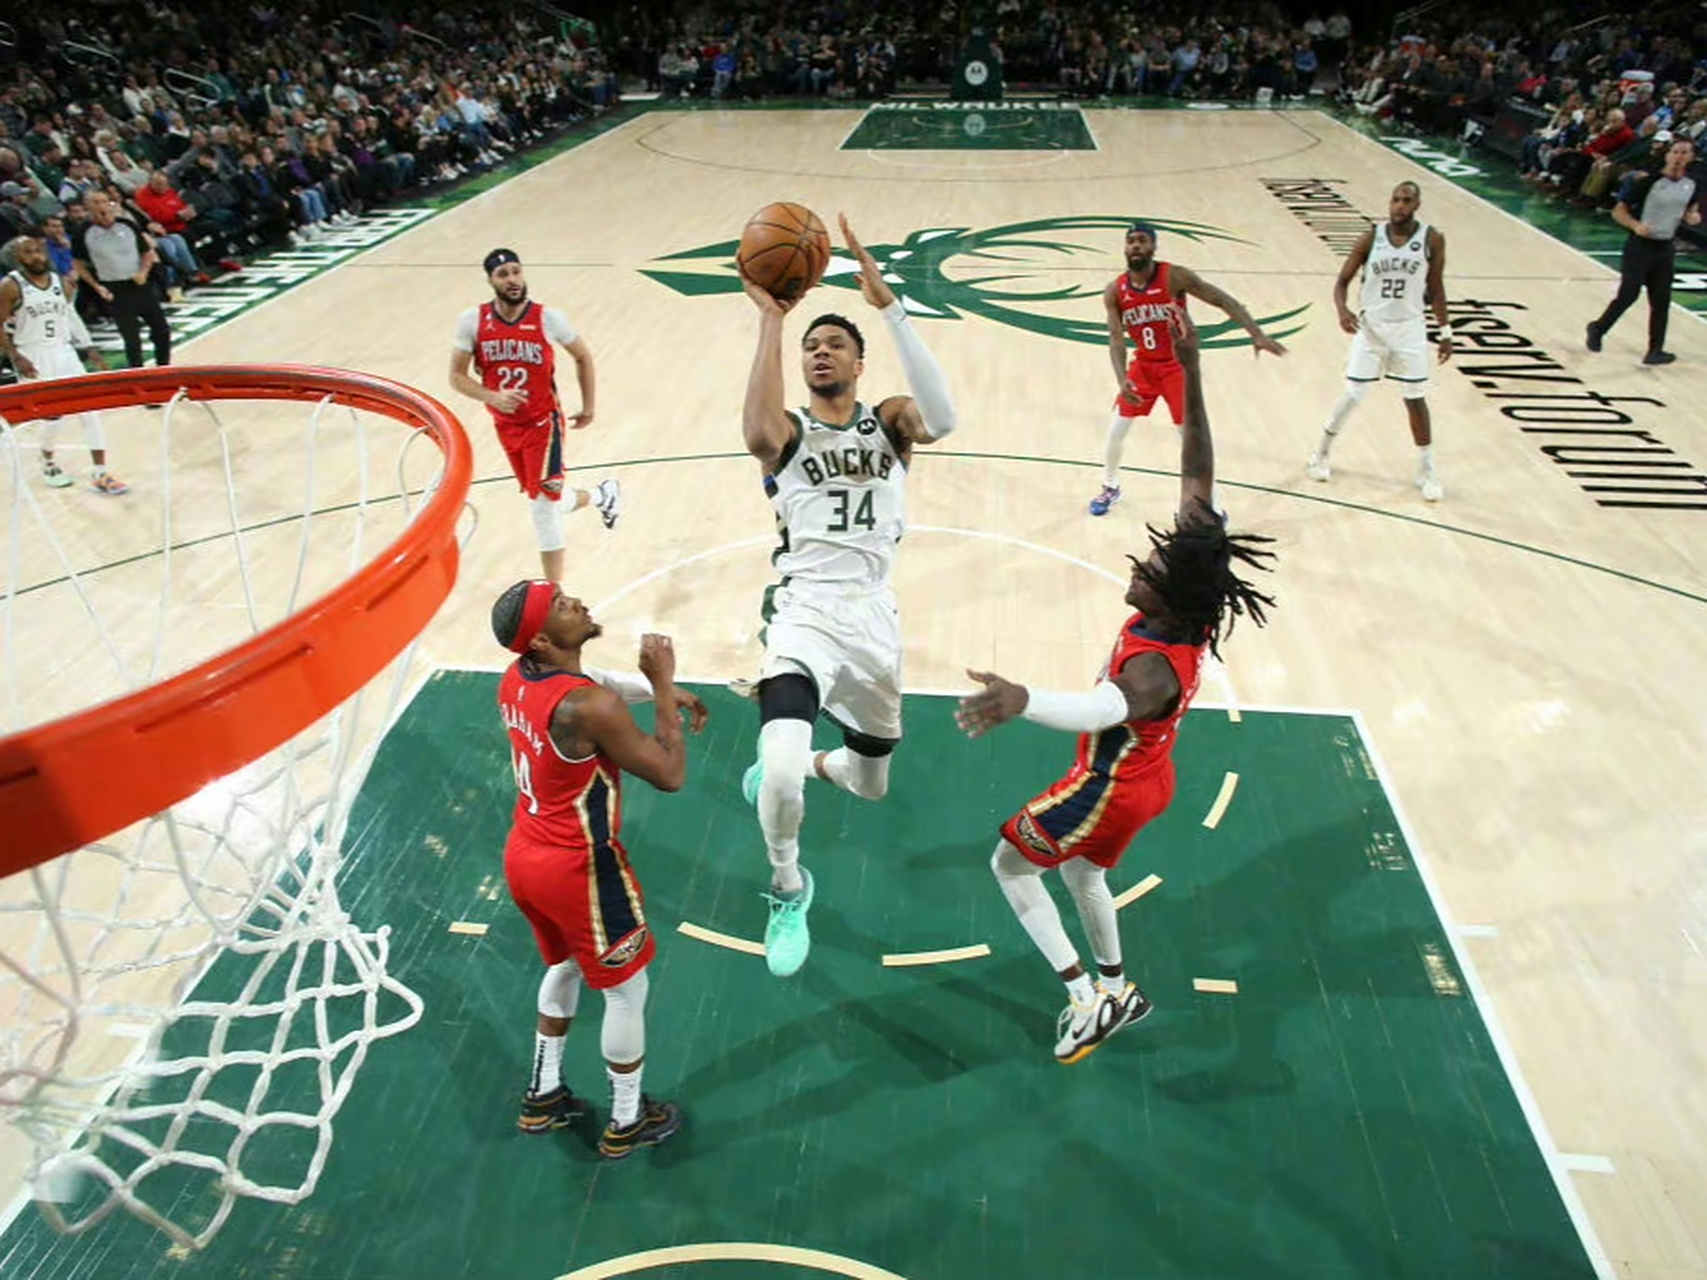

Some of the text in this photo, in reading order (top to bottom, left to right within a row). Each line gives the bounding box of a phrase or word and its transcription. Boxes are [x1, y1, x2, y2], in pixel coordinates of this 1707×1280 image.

[872, 101, 1081, 112] MILWAUKEE
[1371, 257, 1420, 276] BUCKS
[1381, 278, 1405, 299] 22
[44, 319, 56, 338] 5
[1141, 326, 1156, 350] 8
[482, 339, 544, 365] PELICANS
[497, 366, 529, 396] 22
[801, 447, 893, 487] BUCKS
[826, 489, 876, 532] 34
